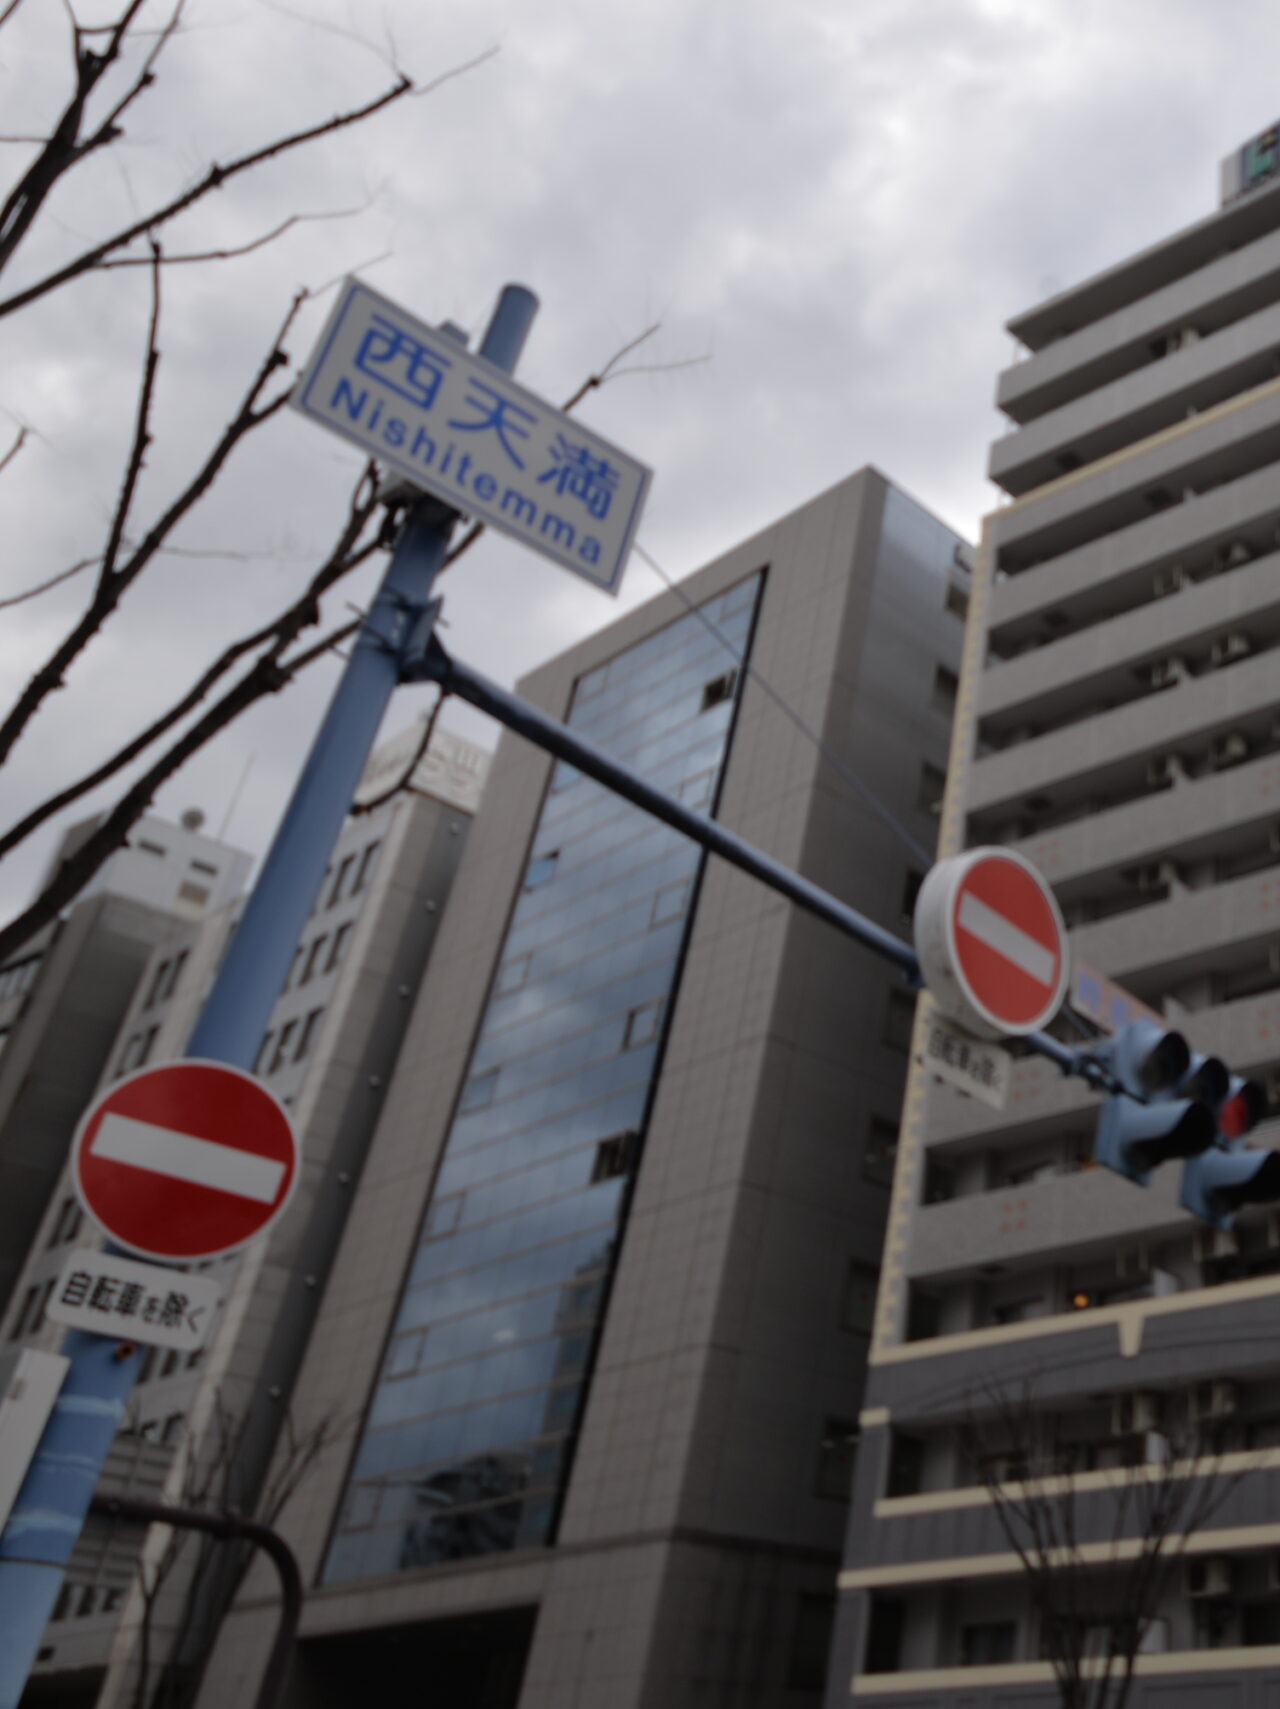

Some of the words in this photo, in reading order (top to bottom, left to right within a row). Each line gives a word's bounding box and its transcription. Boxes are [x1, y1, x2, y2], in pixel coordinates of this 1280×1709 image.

[329, 375, 604, 566] Nishitemma
[353, 312, 622, 521] 西天満
[60, 1268, 206, 1335] 自転車を除く
